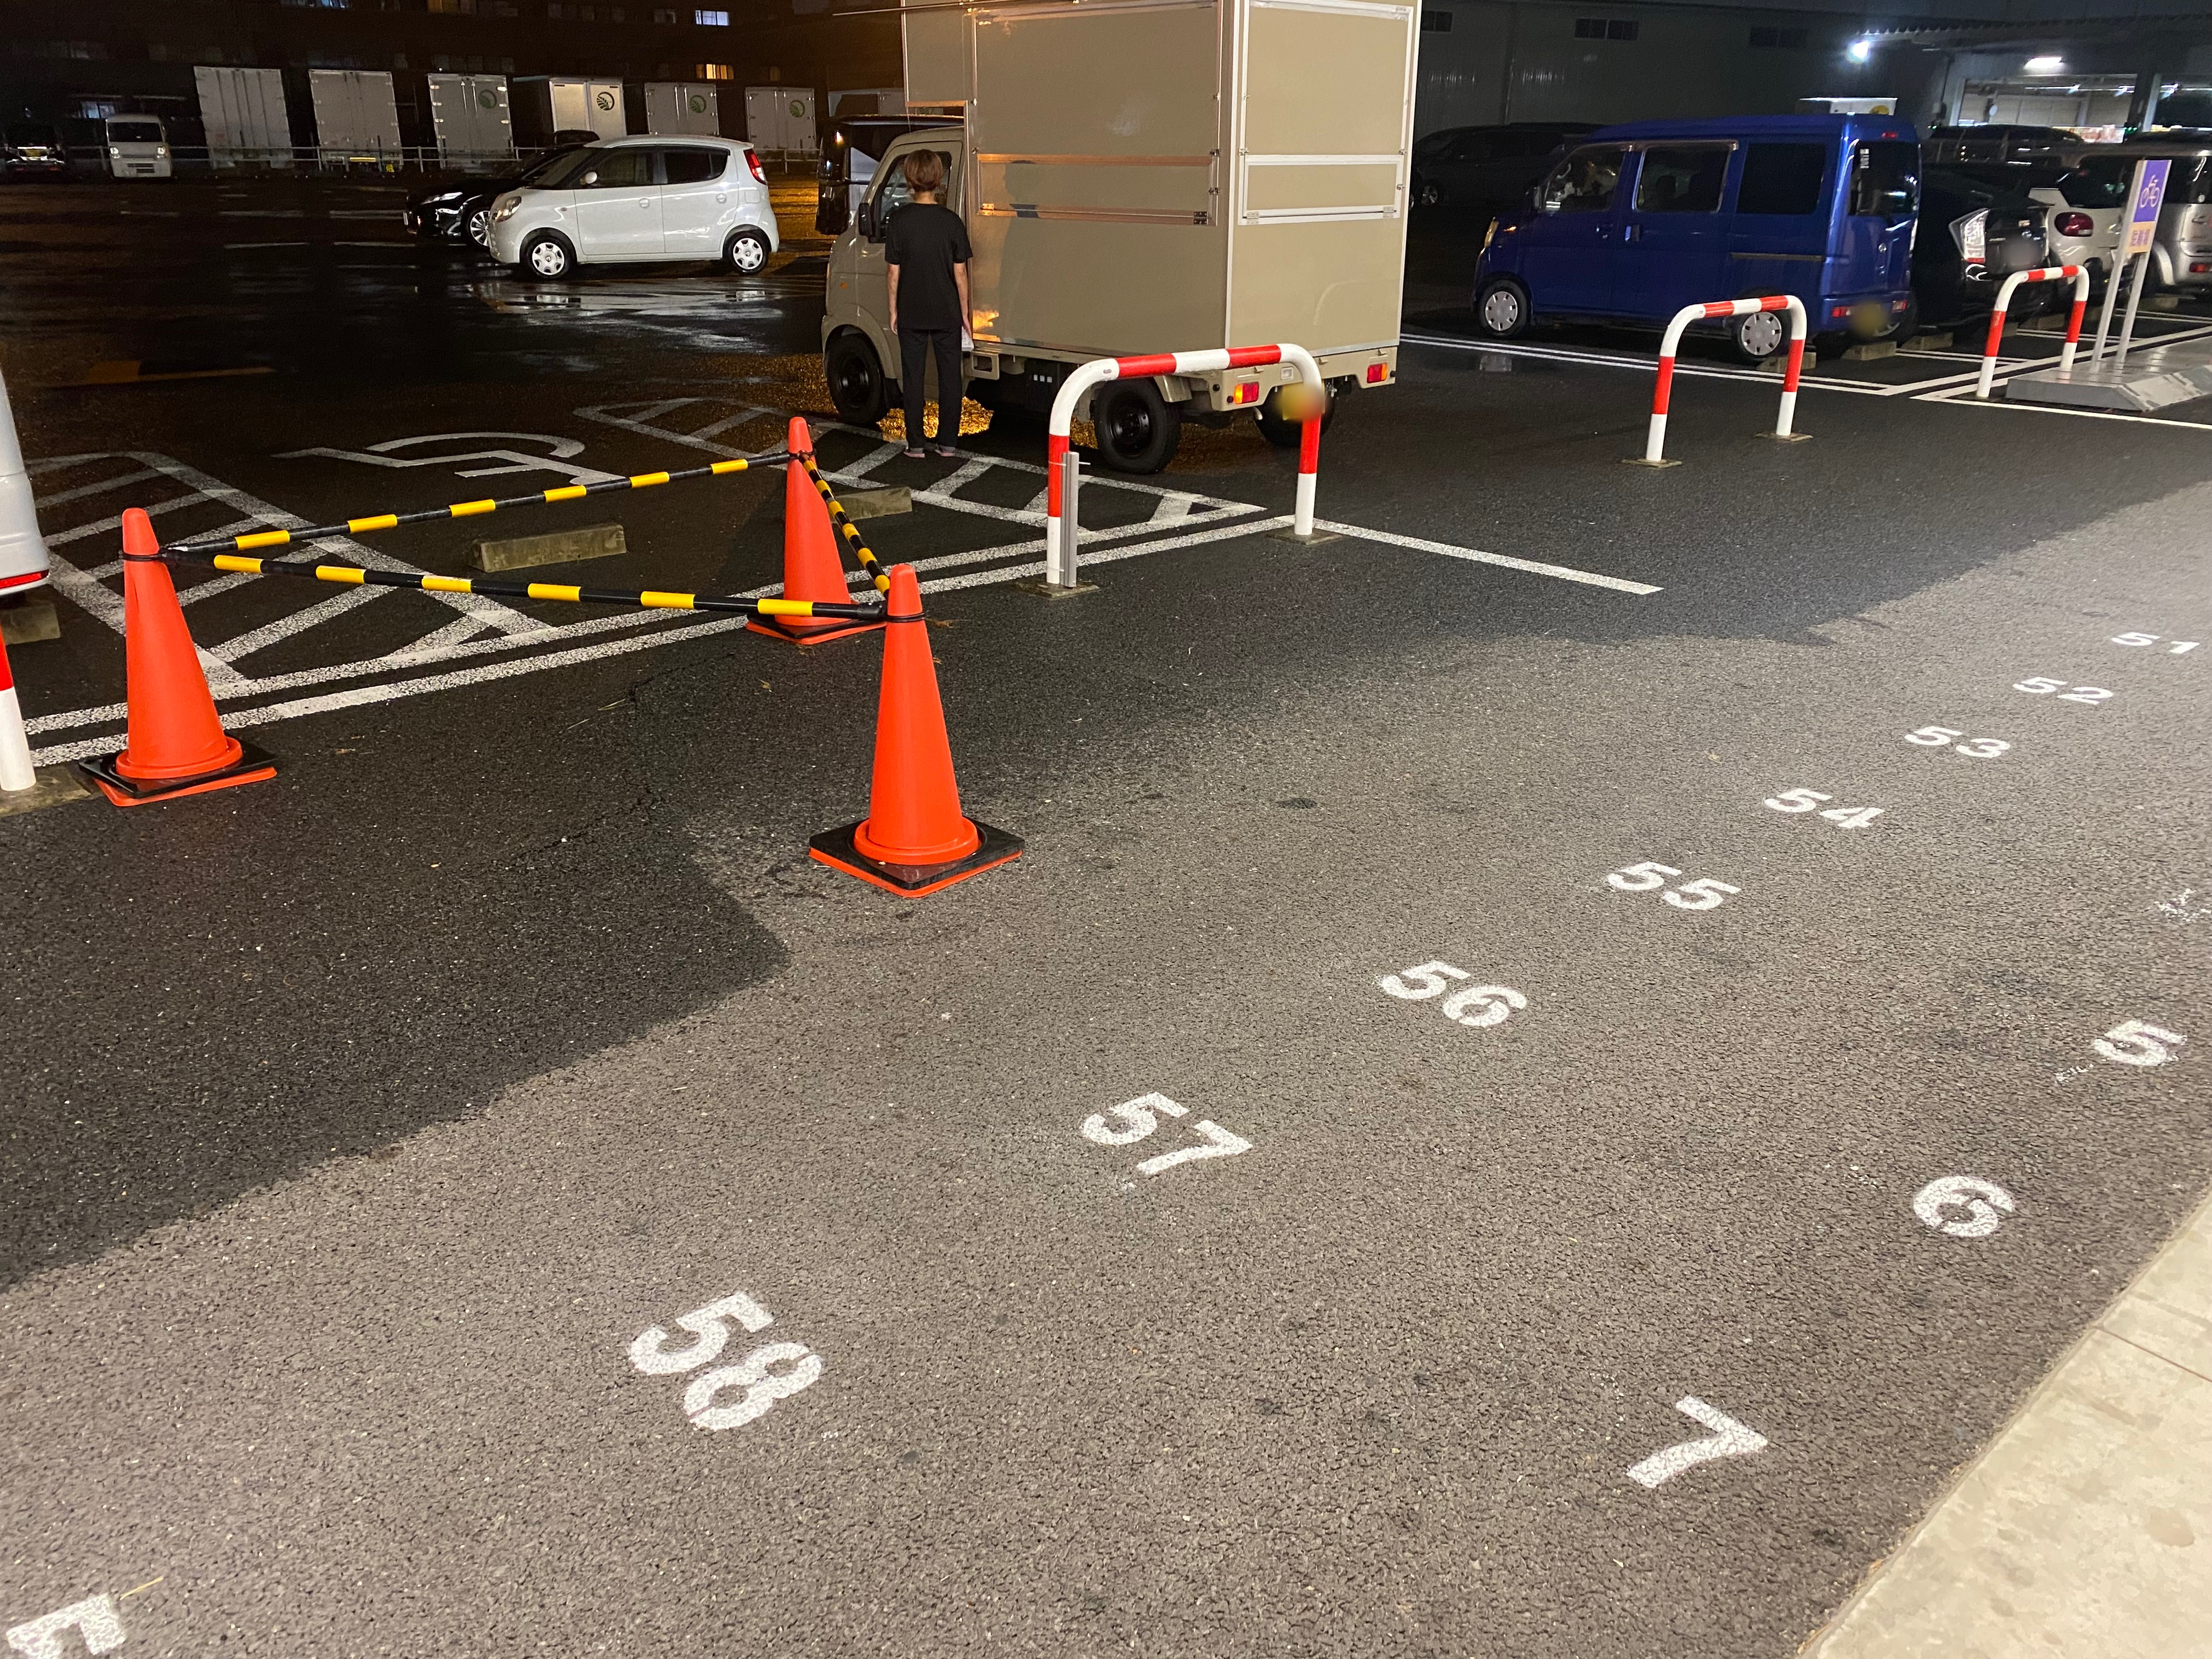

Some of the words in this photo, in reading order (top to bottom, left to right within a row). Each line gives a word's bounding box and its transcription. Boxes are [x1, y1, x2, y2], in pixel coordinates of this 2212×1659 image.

[2111, 632, 2200, 654] 51
[2012, 676, 2114, 705] 52
[1904, 726, 2011, 758] 53
[1763, 788, 1884, 829] 54
[1605, 861, 1741, 910] 55
[1378, 960, 1528, 1027] 56
[2092, 1020, 2186, 1066] 5
[1081, 1092, 1254, 1175] 57
[1912, 1175, 2015, 1237] 6
[627, 1290, 822, 1432] 58
[1626, 1395, 1769, 1489] 7
